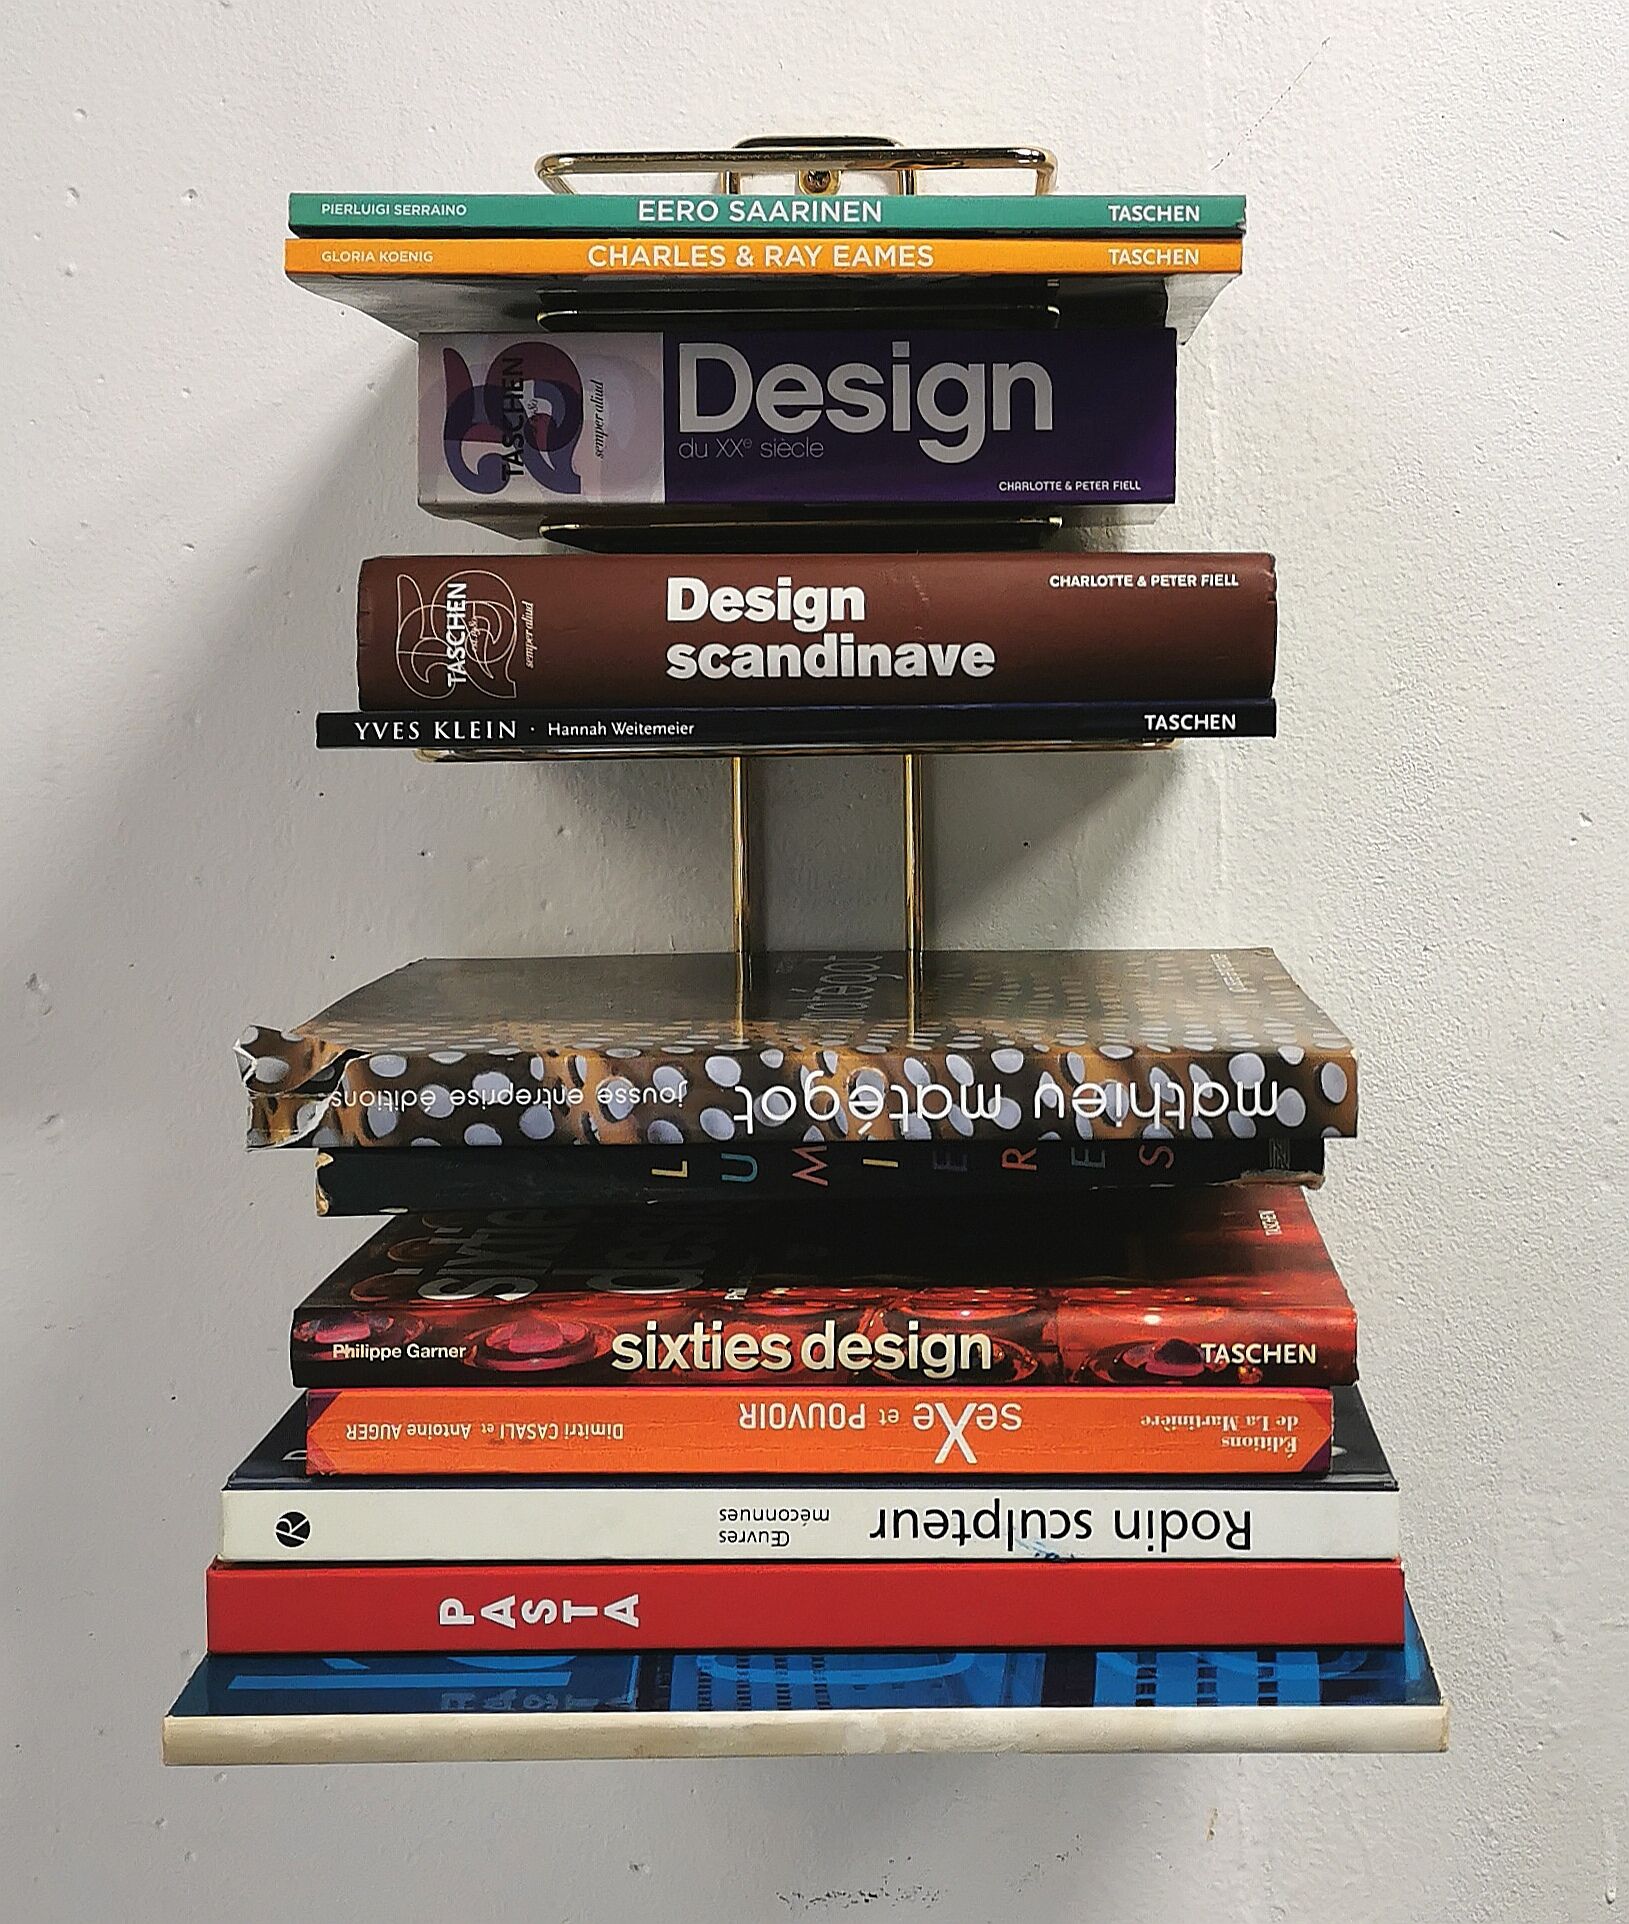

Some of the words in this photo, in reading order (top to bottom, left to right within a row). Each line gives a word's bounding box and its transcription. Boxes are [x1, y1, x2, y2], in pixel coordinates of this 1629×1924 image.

[321, 203, 390, 217] PIERLUIGI
[394, 204, 467, 217] SERRAINO
[638, 200, 719, 223] EERO
[729, 200, 883, 224] SAARINEN
[1108, 204, 1200, 222] TASCHEN
[321, 250, 376, 263] GLORIA
[379, 250, 433, 263] KOENIG
[588, 245, 727, 268] CHARLES
[735, 246, 756, 268] &
[764, 245, 823, 268] RAY
[833, 245, 934, 267] EAMES
[1108, 249, 1200, 266] TASCHEN
[678, 341, 1053, 464] Design
[501, 357, 525, 480] TASCHEN
[678, 437, 708, 459] du
[760, 436, 824, 459] siècle
[998, 480, 1062, 492] CHARLOTTE
[1065, 481, 1073, 491] &
[1075, 480, 1110, 491] PETER
[1112, 480, 1141, 491] FIELL
[1049, 574, 1133, 588] CHARLOTTE
[1136, 575, 1148, 587] &
[1150, 574, 1197, 587] PETER
[1200, 573, 1239, 587] FIELL
[666, 576, 865, 632] Design
[446, 583, 468, 687] TASCHEN
[666, 633, 996, 679] scandinave
[354, 721, 421, 740] YVES
[434, 720, 517, 740] KLEIN
[548, 721, 607, 736] Hannah
[611, 721, 695, 736] Weitemeier
[1144, 714, 1237, 731] TASCHEN
[329, 1083, 437, 1113] éditions
[450, 1082, 584, 1111] entreprise
[597, 1080, 689, 1109] jousse
[733, 1069, 1001, 1136] matégot
[1033, 1080, 1279, 1130] mathieu
[332, 1343, 402, 1361] Philippe
[406, 1343, 466, 1360] Garner
[611, 1320, 791, 1371] sixties
[801, 1320, 992, 1377] design
[1201, 1343, 1316, 1364] TASCHEN
[738, 1402, 866, 1431] POUVOIR
[879, 1408, 899, 1425] et
[1140, 1415, 1236, 1431] Martinière
[1246, 1416, 1271, 1431] La
[1281, 1415, 1299, 1431] de
[346, 1423, 402, 1440] AUGER
[407, 1423, 471, 1440] Antoine
[481, 1424, 494, 1434] et
[500, 1423, 559, 1440] CASALI
[565, 1423, 624, 1440] Dimitri
[1221, 1436, 1298, 1461] Éditions
[718, 1507, 830, 1527] méconnues
[868, 1497, 1092, 1552] sculpteur
[718, 1530, 791, 1547] Œuvres
[1113, 1509, 1252, 1552] Rodin
[438, 1593, 640, 1629] PASTA
